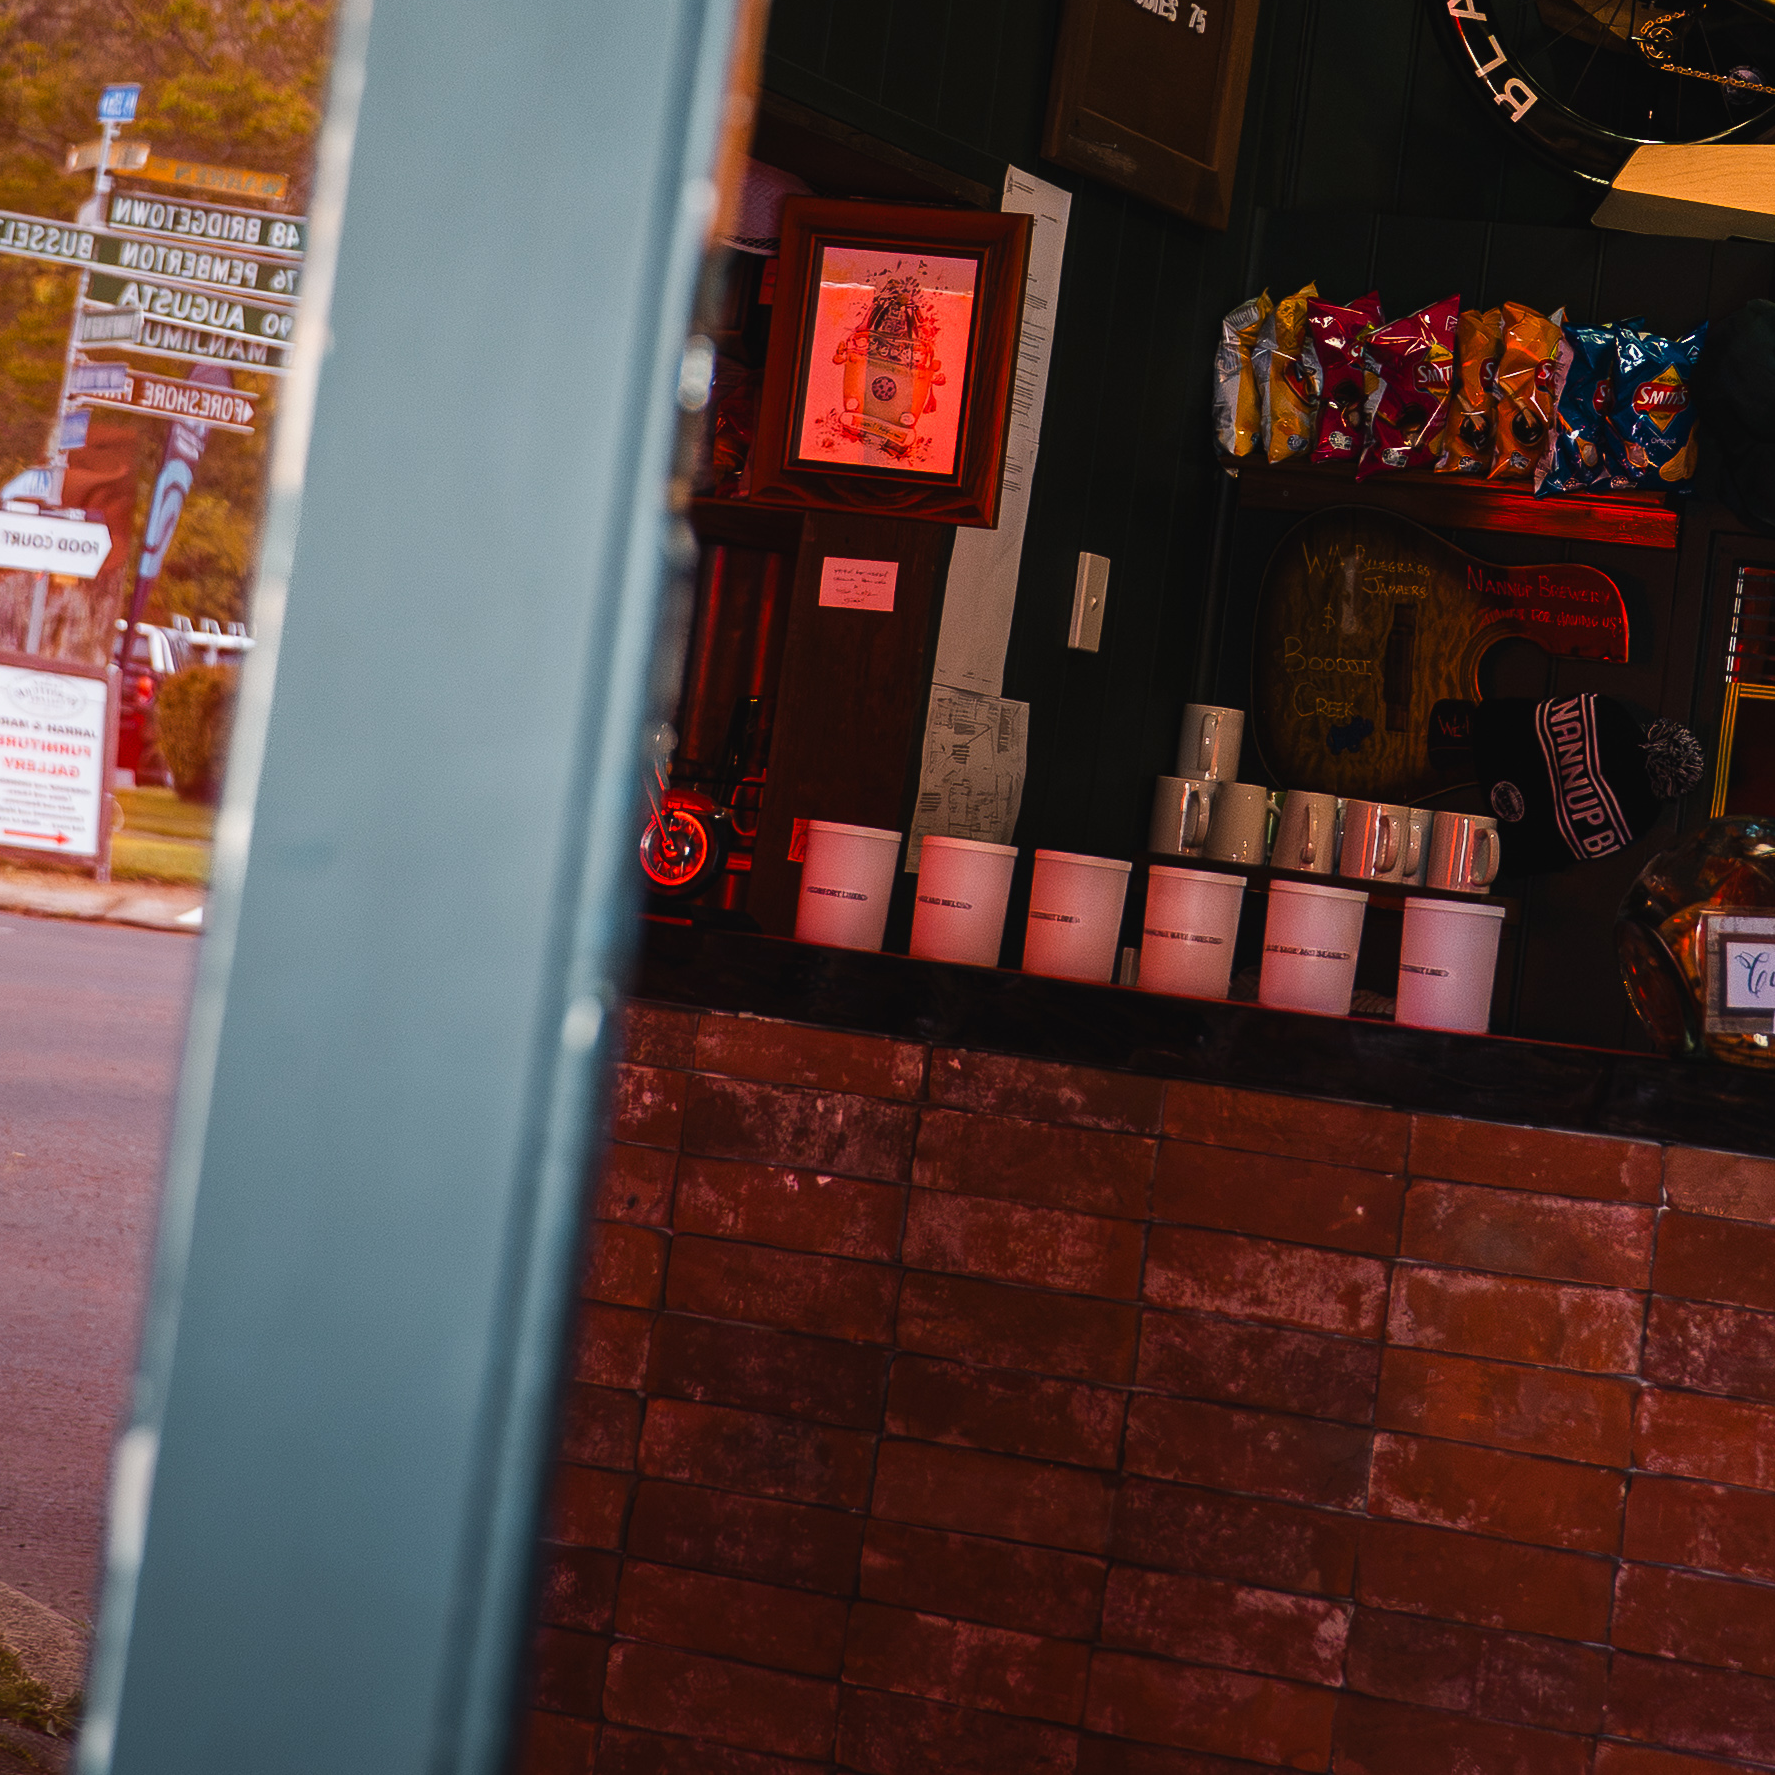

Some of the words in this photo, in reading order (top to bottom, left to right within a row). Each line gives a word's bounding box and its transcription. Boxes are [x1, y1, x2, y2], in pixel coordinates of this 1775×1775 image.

[1189, 3, 1207, 34] 75
[1418, 362, 1453, 384] SMIT
[1550, 697, 1606, 826] NANNUP
